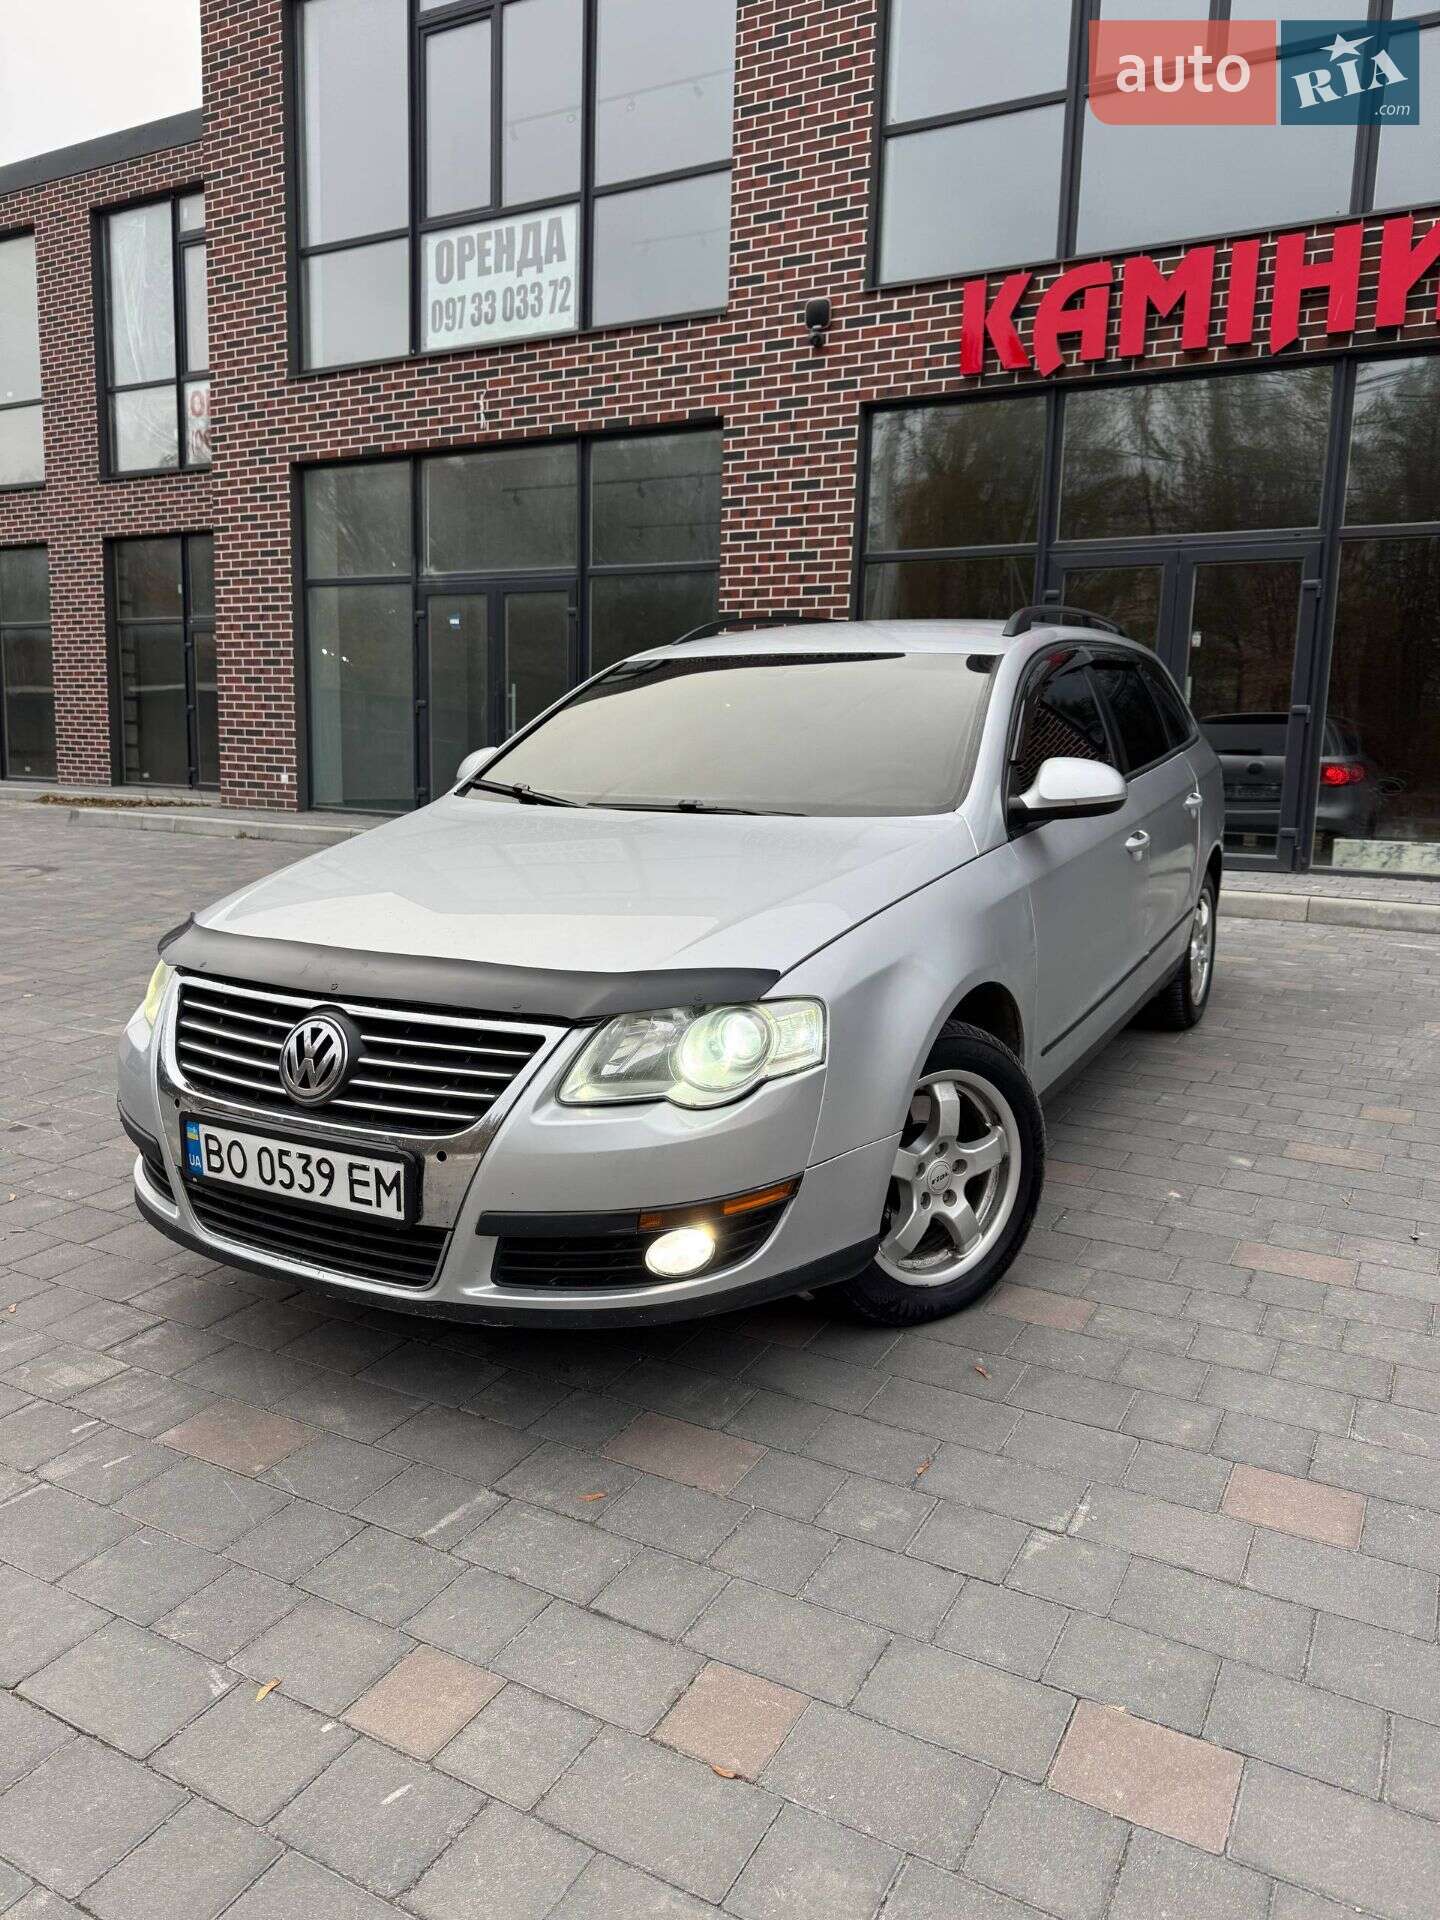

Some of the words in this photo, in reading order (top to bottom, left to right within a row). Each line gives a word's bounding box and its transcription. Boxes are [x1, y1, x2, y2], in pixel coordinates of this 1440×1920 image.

[434, 216, 567, 285] ОРЕНДА
[431, 295, 466, 333] 097
[470, 290, 497, 327] 33
[502, 281, 544, 322] 033
[548, 276, 572, 314] 72
[188, 1153, 202, 1168] UA
[204, 1133, 248, 1179] BO
[257, 1146, 335, 1198] 0539
[348, 1161, 402, 1212] EM
